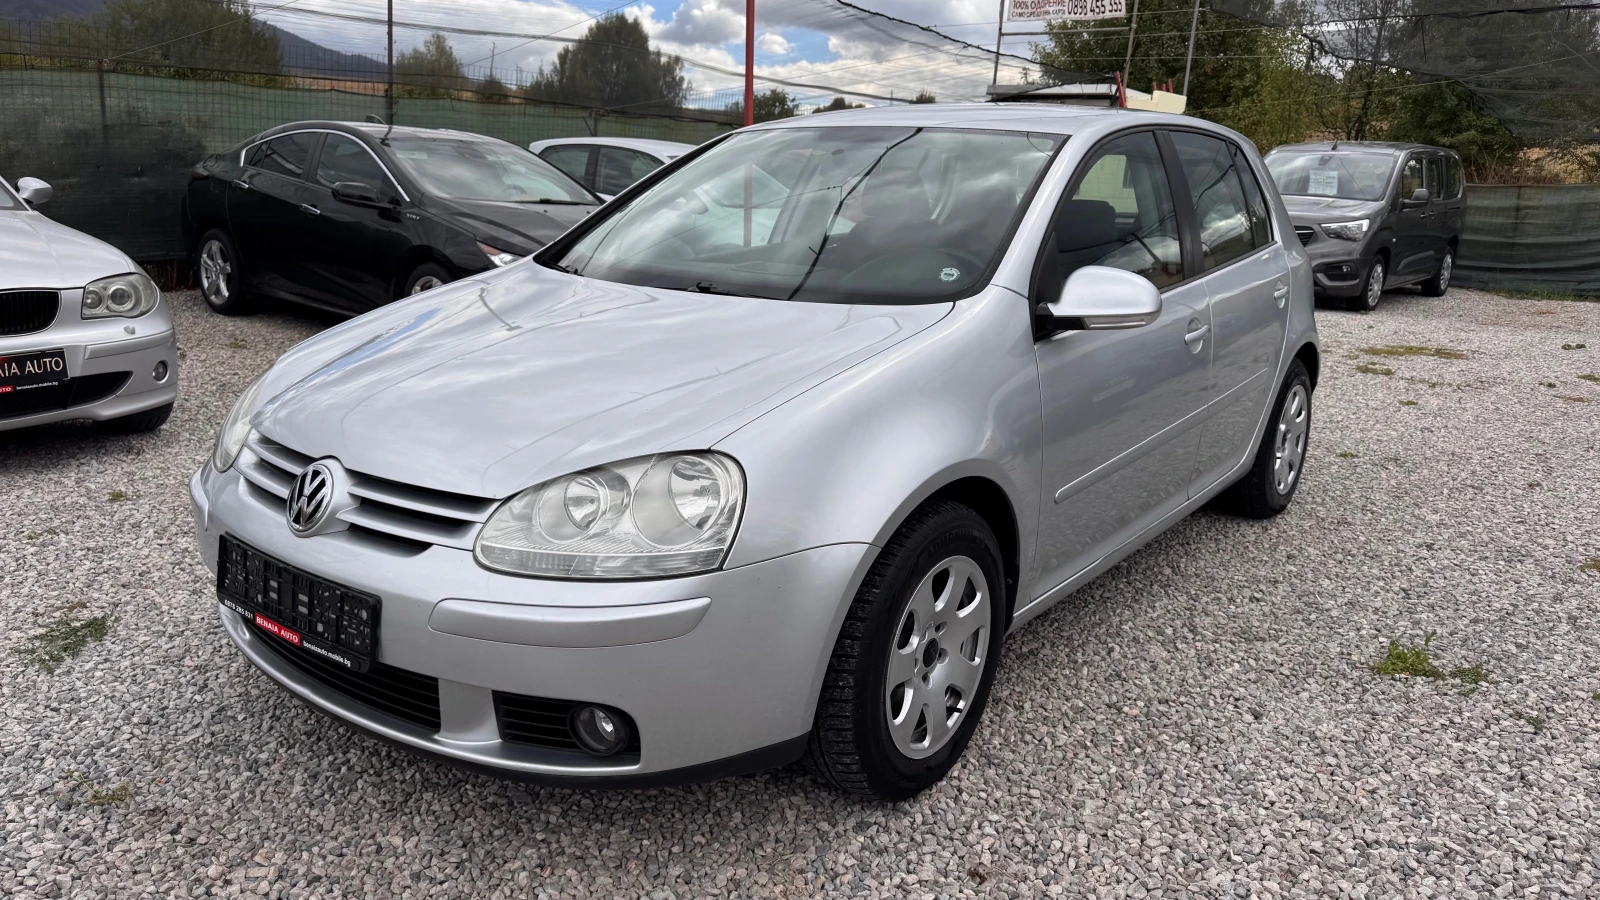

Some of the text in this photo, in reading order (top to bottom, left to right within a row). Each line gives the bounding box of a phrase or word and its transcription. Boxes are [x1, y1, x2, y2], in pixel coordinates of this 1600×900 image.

[1067, 0, 1088, 16] 0898
[0, 357, 63, 377] IA AUTO
[256, 616, 299, 643] BENAIA AUTO
